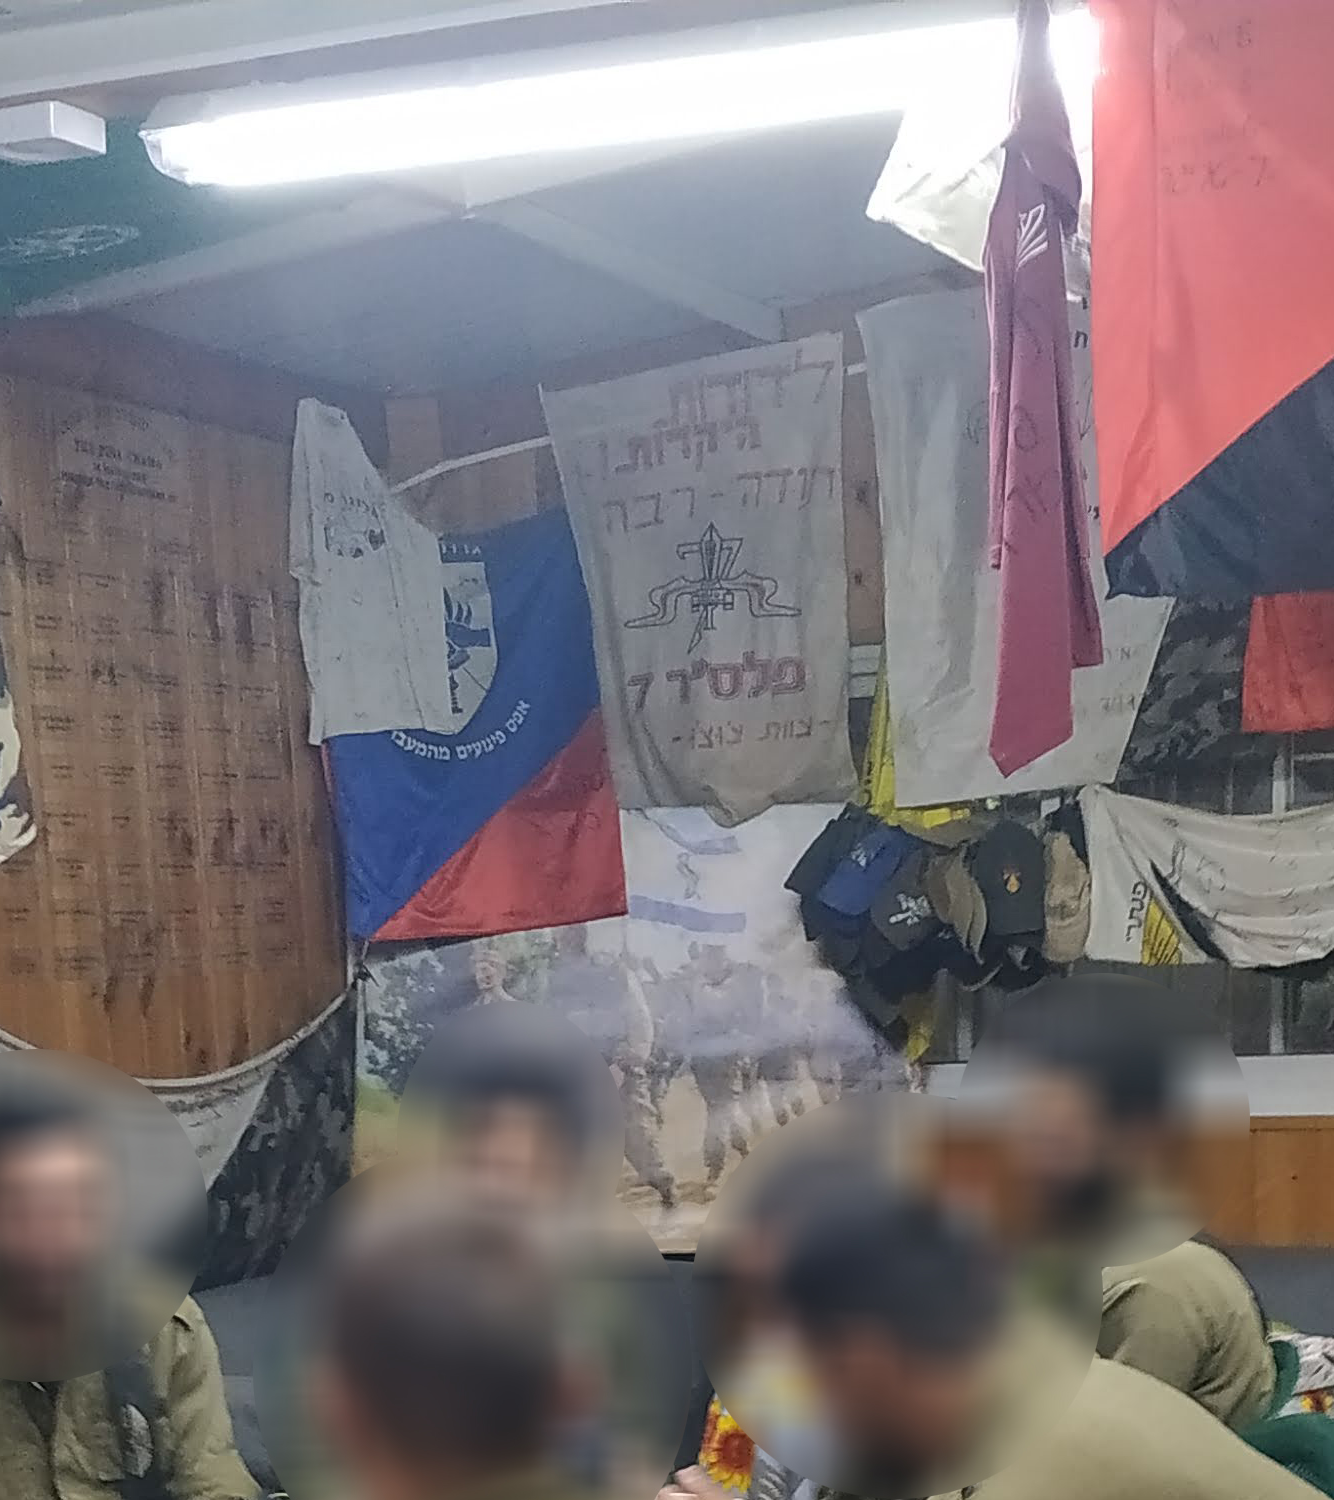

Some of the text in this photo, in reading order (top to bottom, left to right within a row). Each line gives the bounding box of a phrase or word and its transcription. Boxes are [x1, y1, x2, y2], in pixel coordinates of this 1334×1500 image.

[602, 466, 836, 534] תודה רבה
[627, 671, 655, 713] 7
[456, 730, 506, 760] פיגועים
